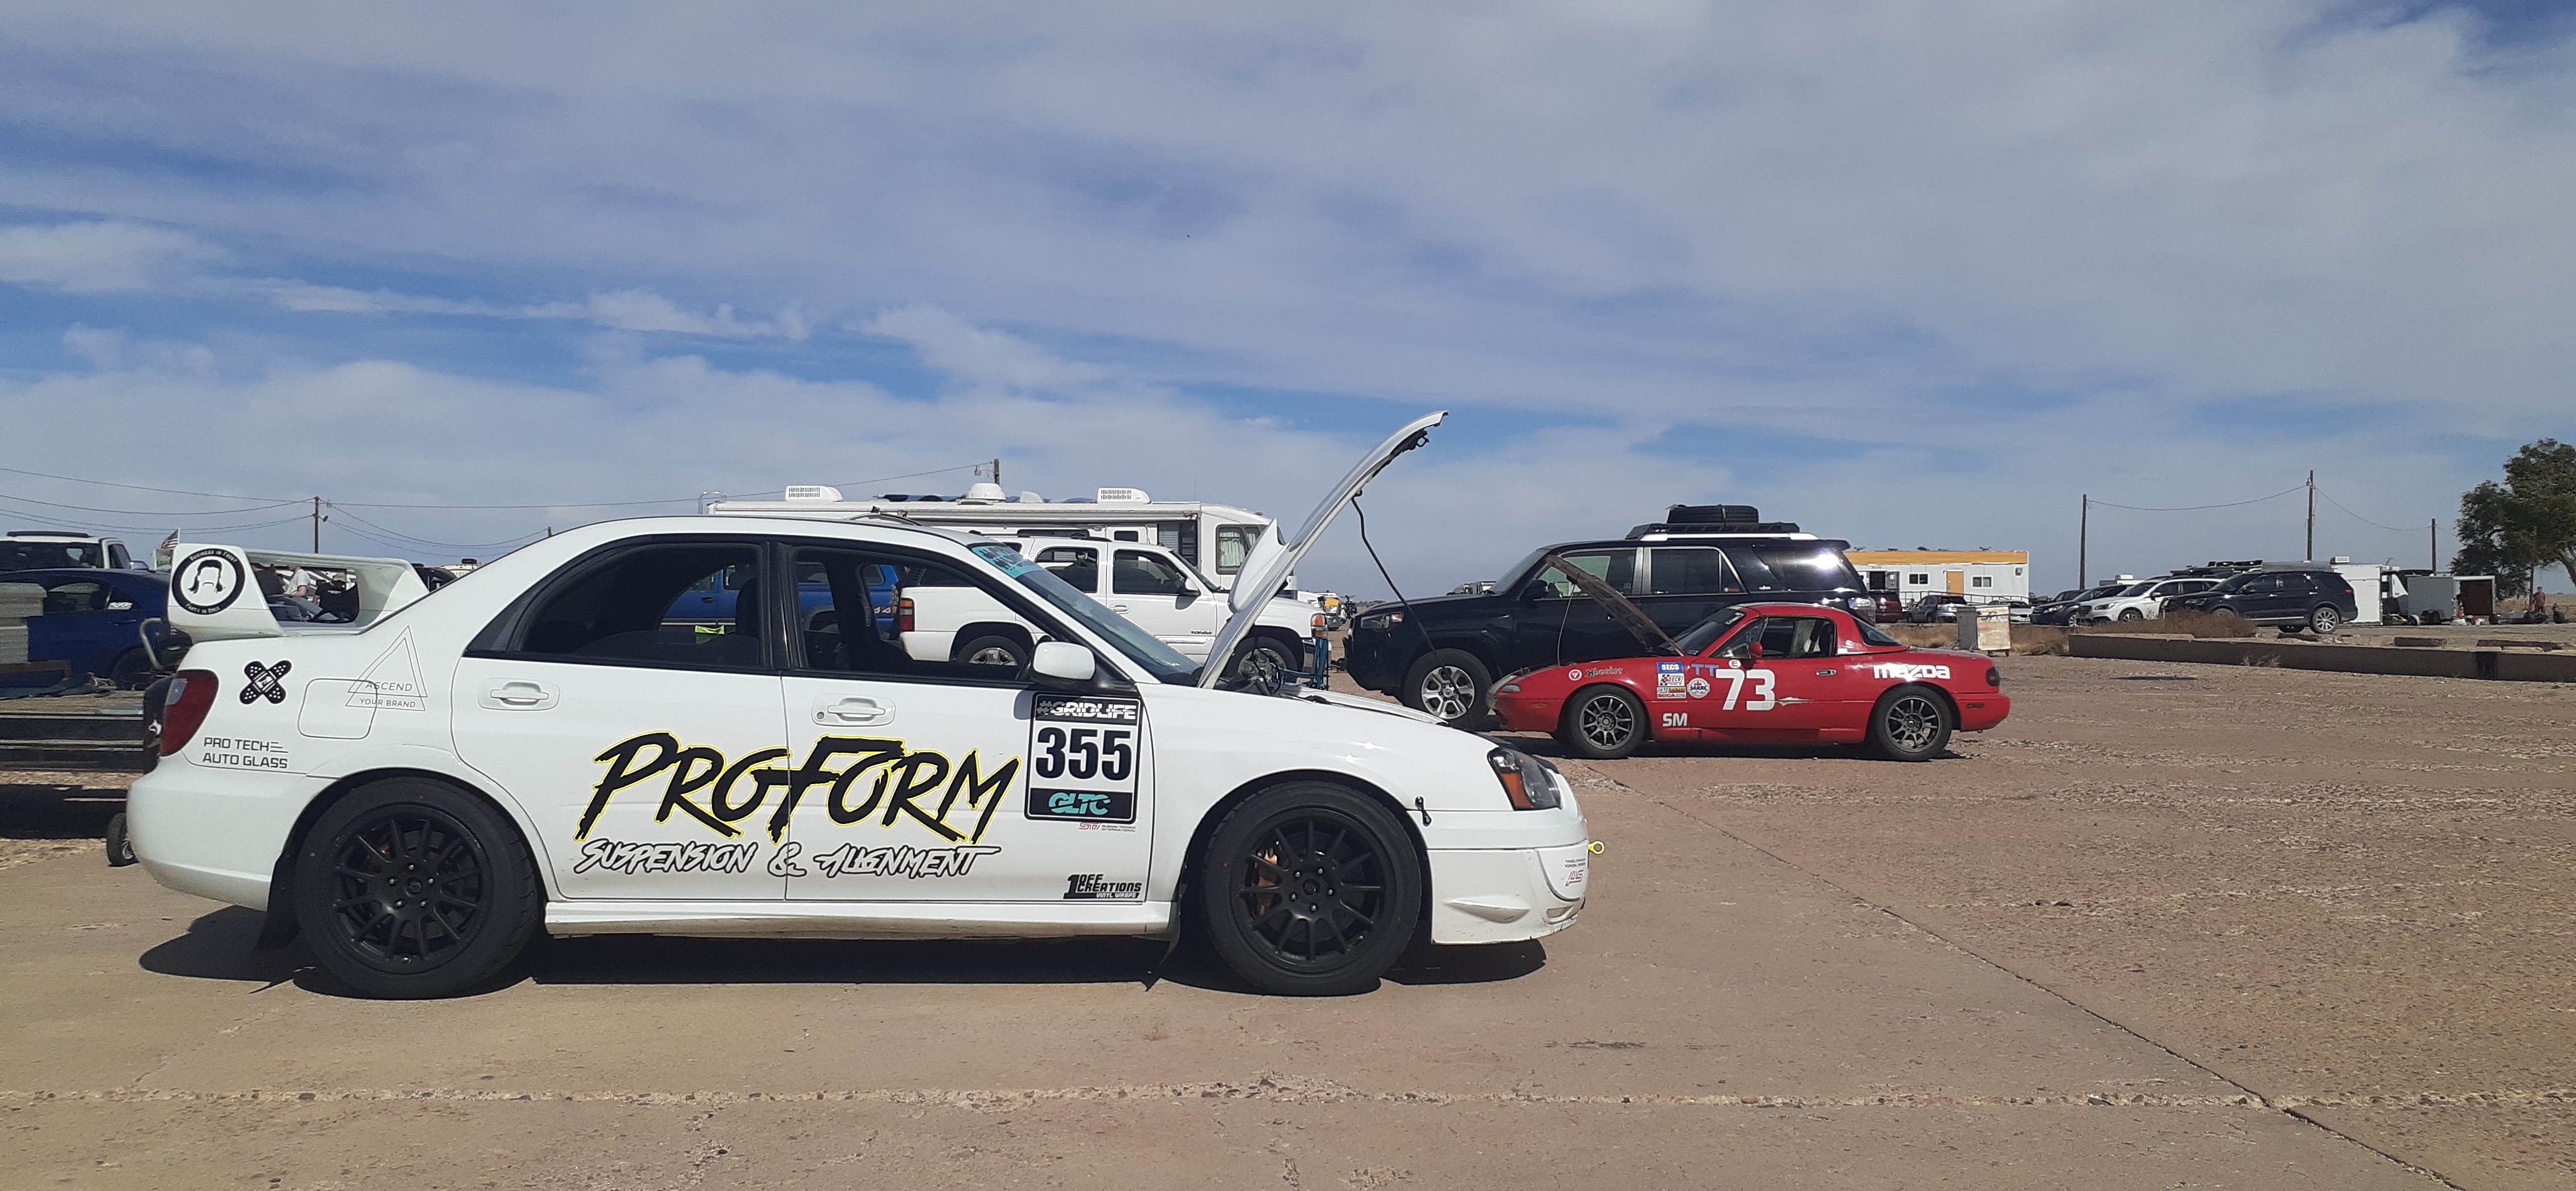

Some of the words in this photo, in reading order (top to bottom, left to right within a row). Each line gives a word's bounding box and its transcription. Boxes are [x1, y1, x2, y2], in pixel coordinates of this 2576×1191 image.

[1691, 664, 1719, 677] TT
[365, 682, 413, 692] ASCEND
[1715, 669, 1775, 710] 73
[359, 697, 383, 706] YOUR
[386, 700, 416, 708] BRAND
[1037, 700, 1137, 720] #GRIDLIFE
[1662, 713, 1688, 727] SM
[203, 737, 231, 749] PRO
[235, 739, 270, 752] TECH
[202, 752, 240, 765] AUTO
[243, 755, 288, 769] GLASS
[1035, 727, 1132, 781] 355
[1048, 792, 1111, 815] GLTC
[573, 838, 759, 875] SUSPENSION
[767, 841, 807, 877] &
[812, 842, 1002, 879] ALIGNMENT
[1078, 874, 1104, 884] OFF
[1076, 882, 1143, 893] CREATIONS
